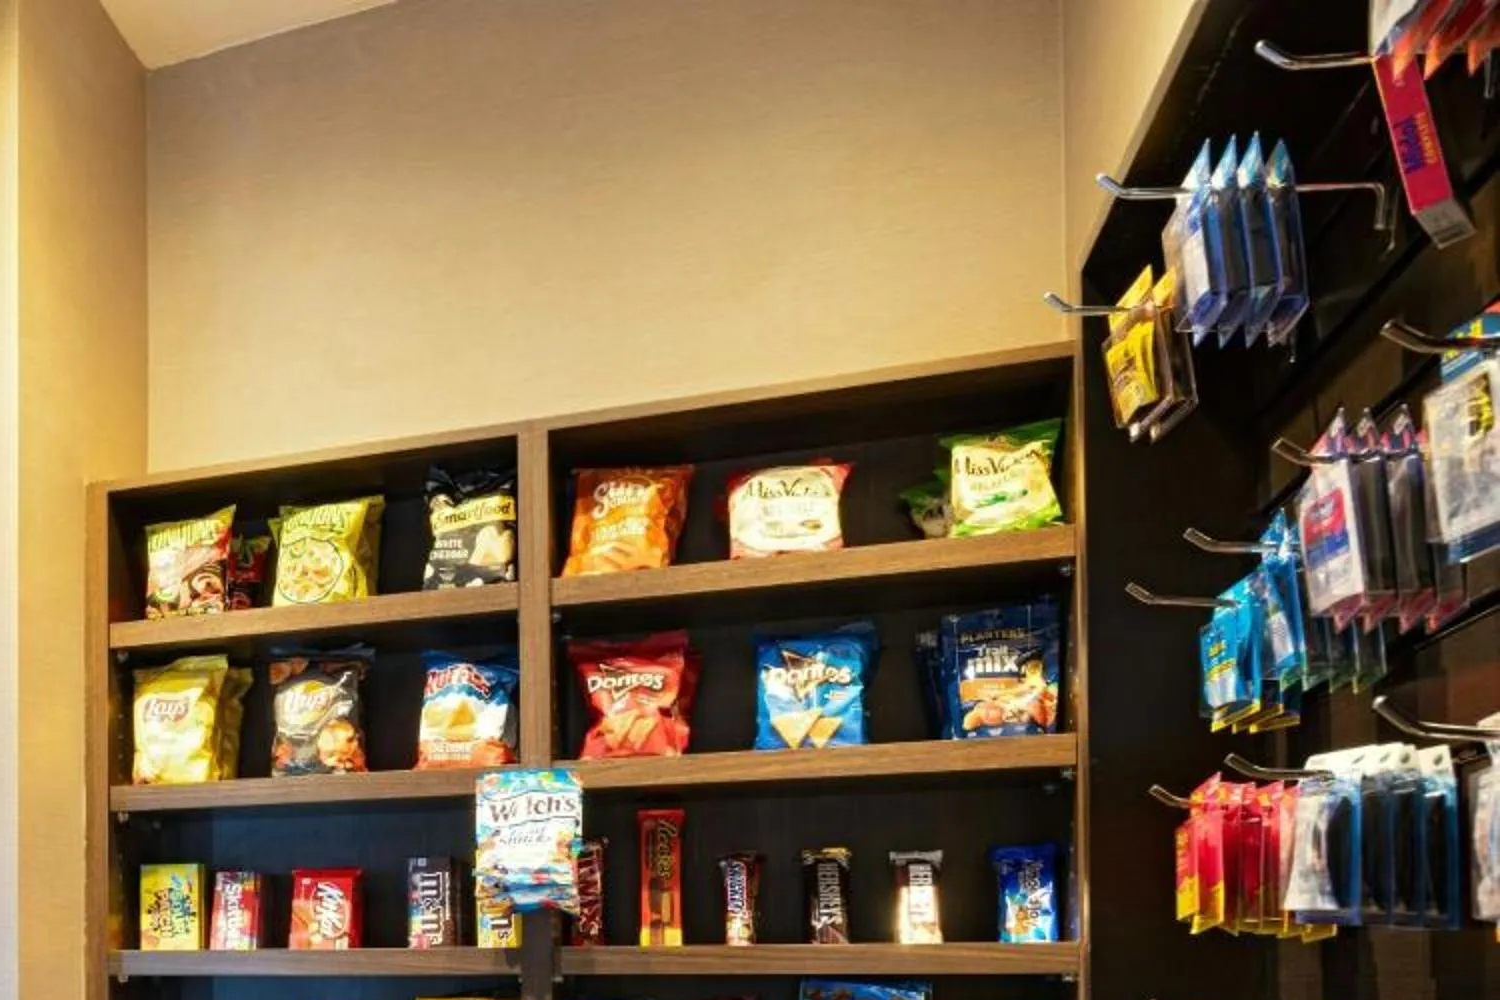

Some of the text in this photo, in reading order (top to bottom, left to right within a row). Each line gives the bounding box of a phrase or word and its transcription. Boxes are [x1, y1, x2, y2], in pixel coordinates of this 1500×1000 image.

[587, 671, 665, 693] Doritos
[765, 661, 852, 686] Doritos
[490, 796, 577, 823] Wlch's
[818, 862, 842, 926] HERSHEY'S
